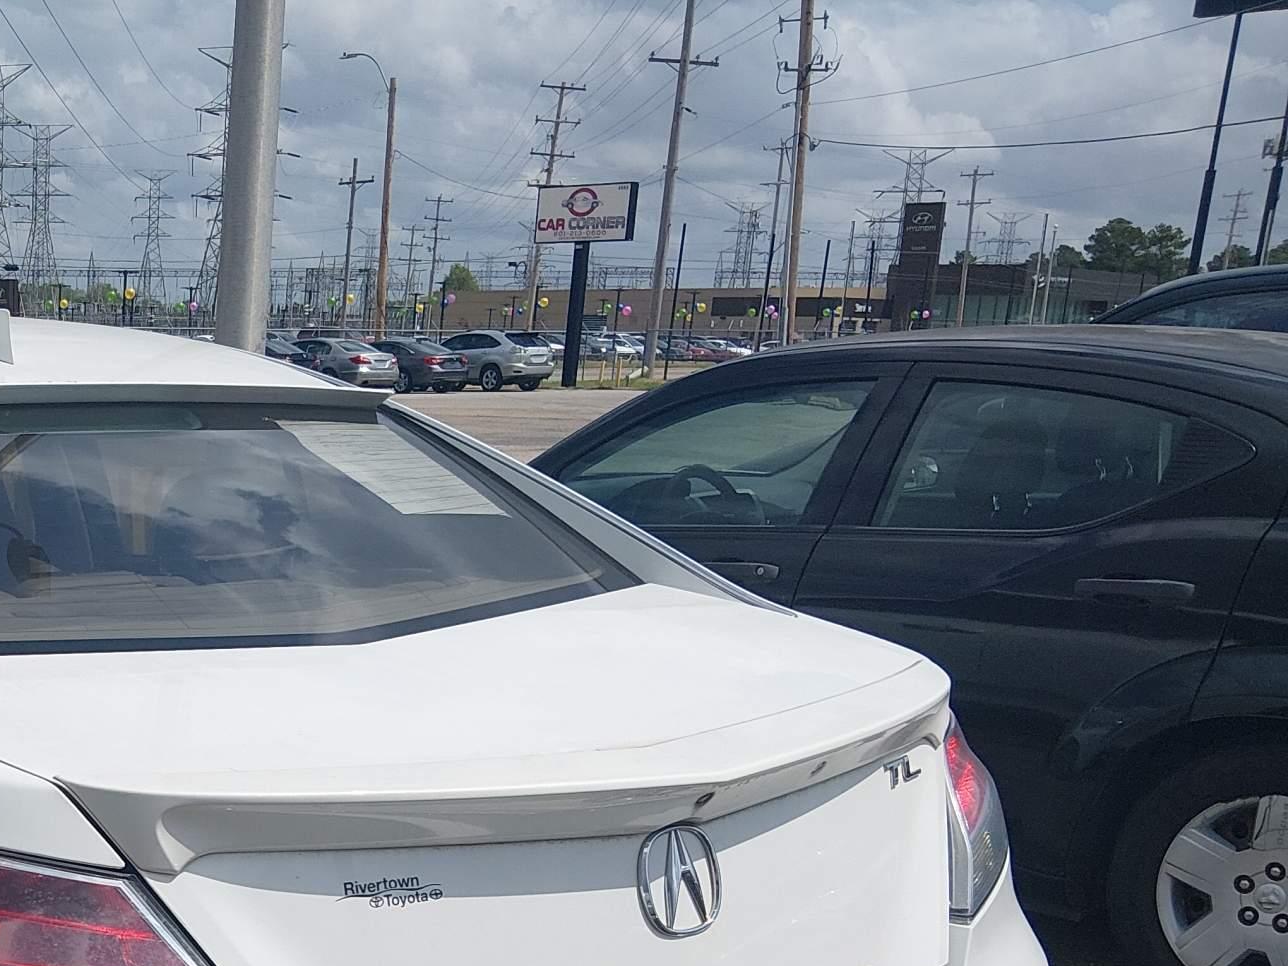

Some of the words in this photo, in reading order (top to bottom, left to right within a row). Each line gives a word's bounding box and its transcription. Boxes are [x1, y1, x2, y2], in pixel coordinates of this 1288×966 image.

[538, 218, 565, 231] CAR
[568, 215, 626, 231] CORNER
[883, 754, 922, 790] TL
[344, 876, 420, 896] Rivertown
[384, 890, 429, 908] Toyota
